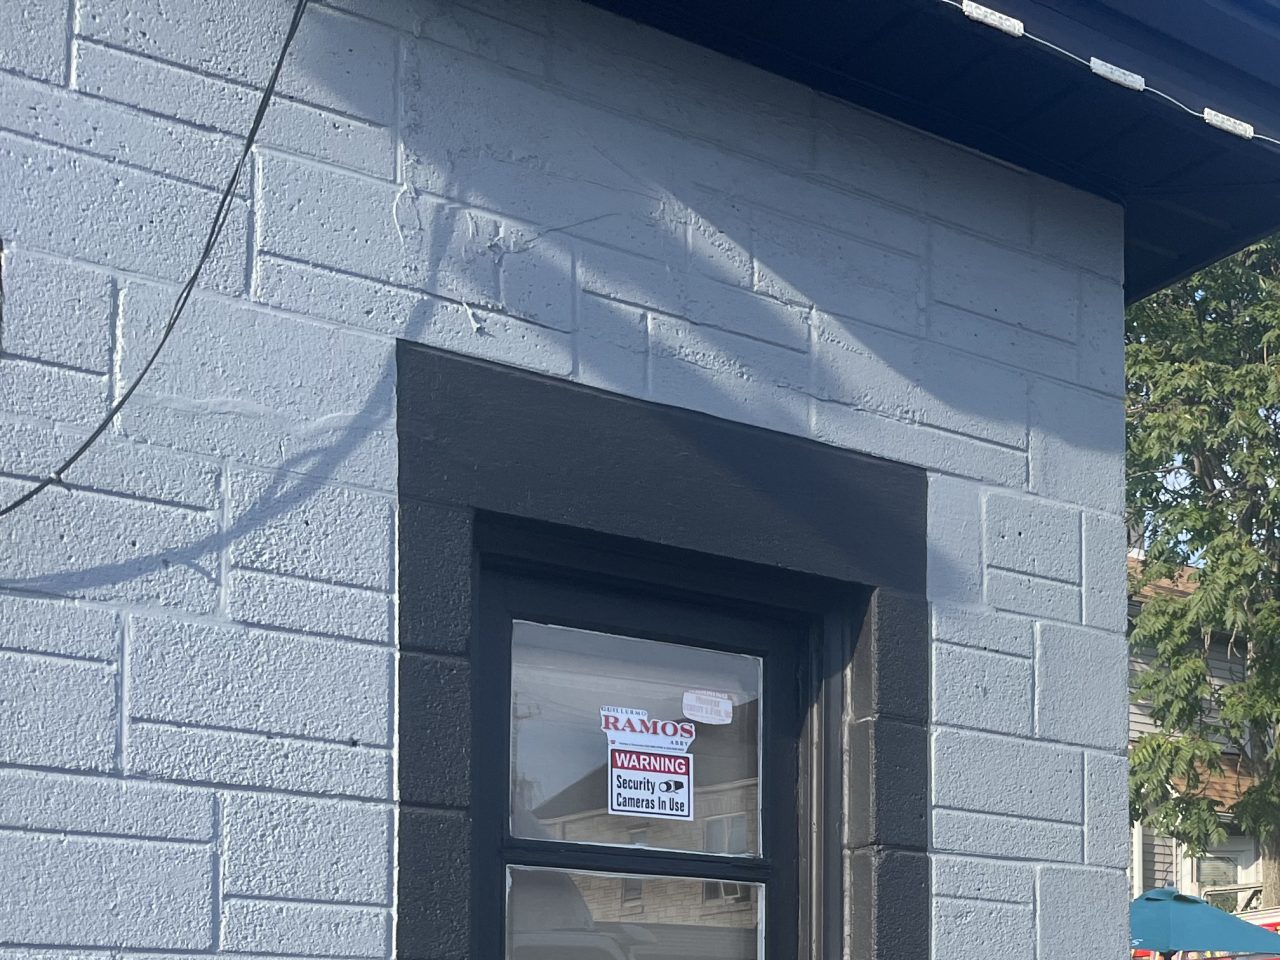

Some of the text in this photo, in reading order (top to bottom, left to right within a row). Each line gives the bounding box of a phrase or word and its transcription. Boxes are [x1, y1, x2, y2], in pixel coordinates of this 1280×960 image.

[602, 714, 694, 739] RAMOS
[615, 752, 686, 773] WARNING
[616, 774, 656, 795] Security
[616, 792, 685, 813] Cameras In Use
